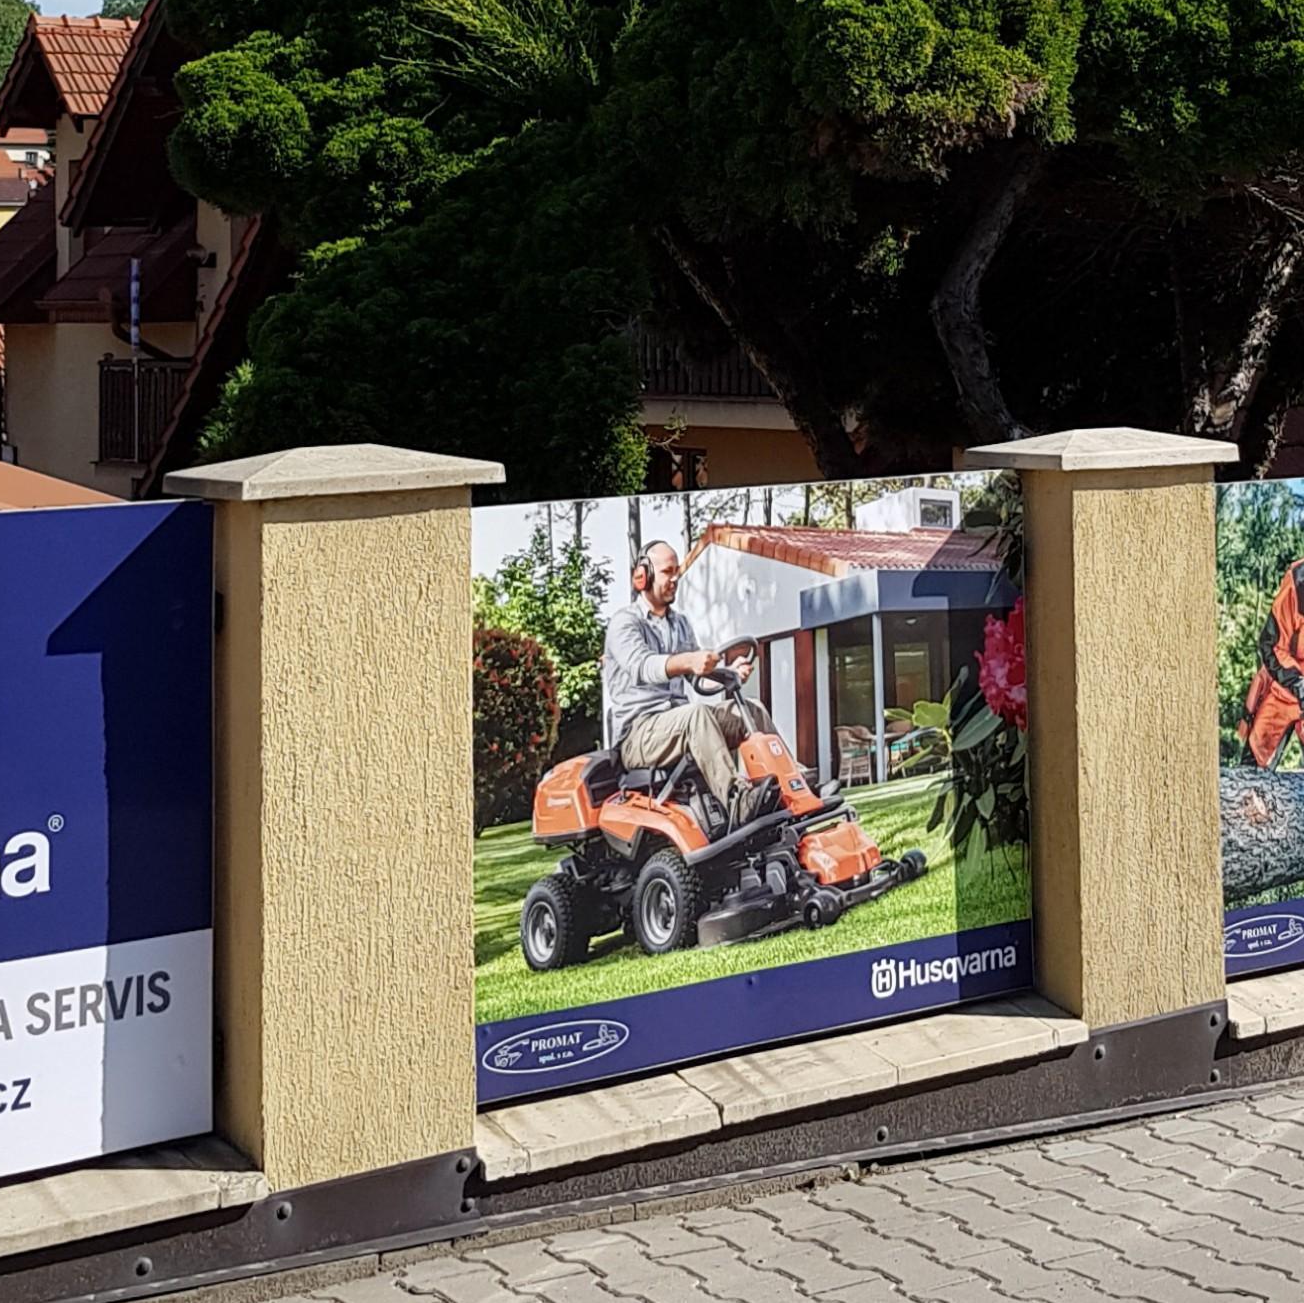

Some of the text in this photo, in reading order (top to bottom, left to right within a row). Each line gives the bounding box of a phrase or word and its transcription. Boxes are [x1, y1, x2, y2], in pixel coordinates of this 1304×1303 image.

[1241, 923, 1278, 940] PROMAT
[898, 945, 1017, 989] Husqvarna
[26, 970, 172, 1037] SERVIS
[531, 1031, 584, 1053] PROMAT
